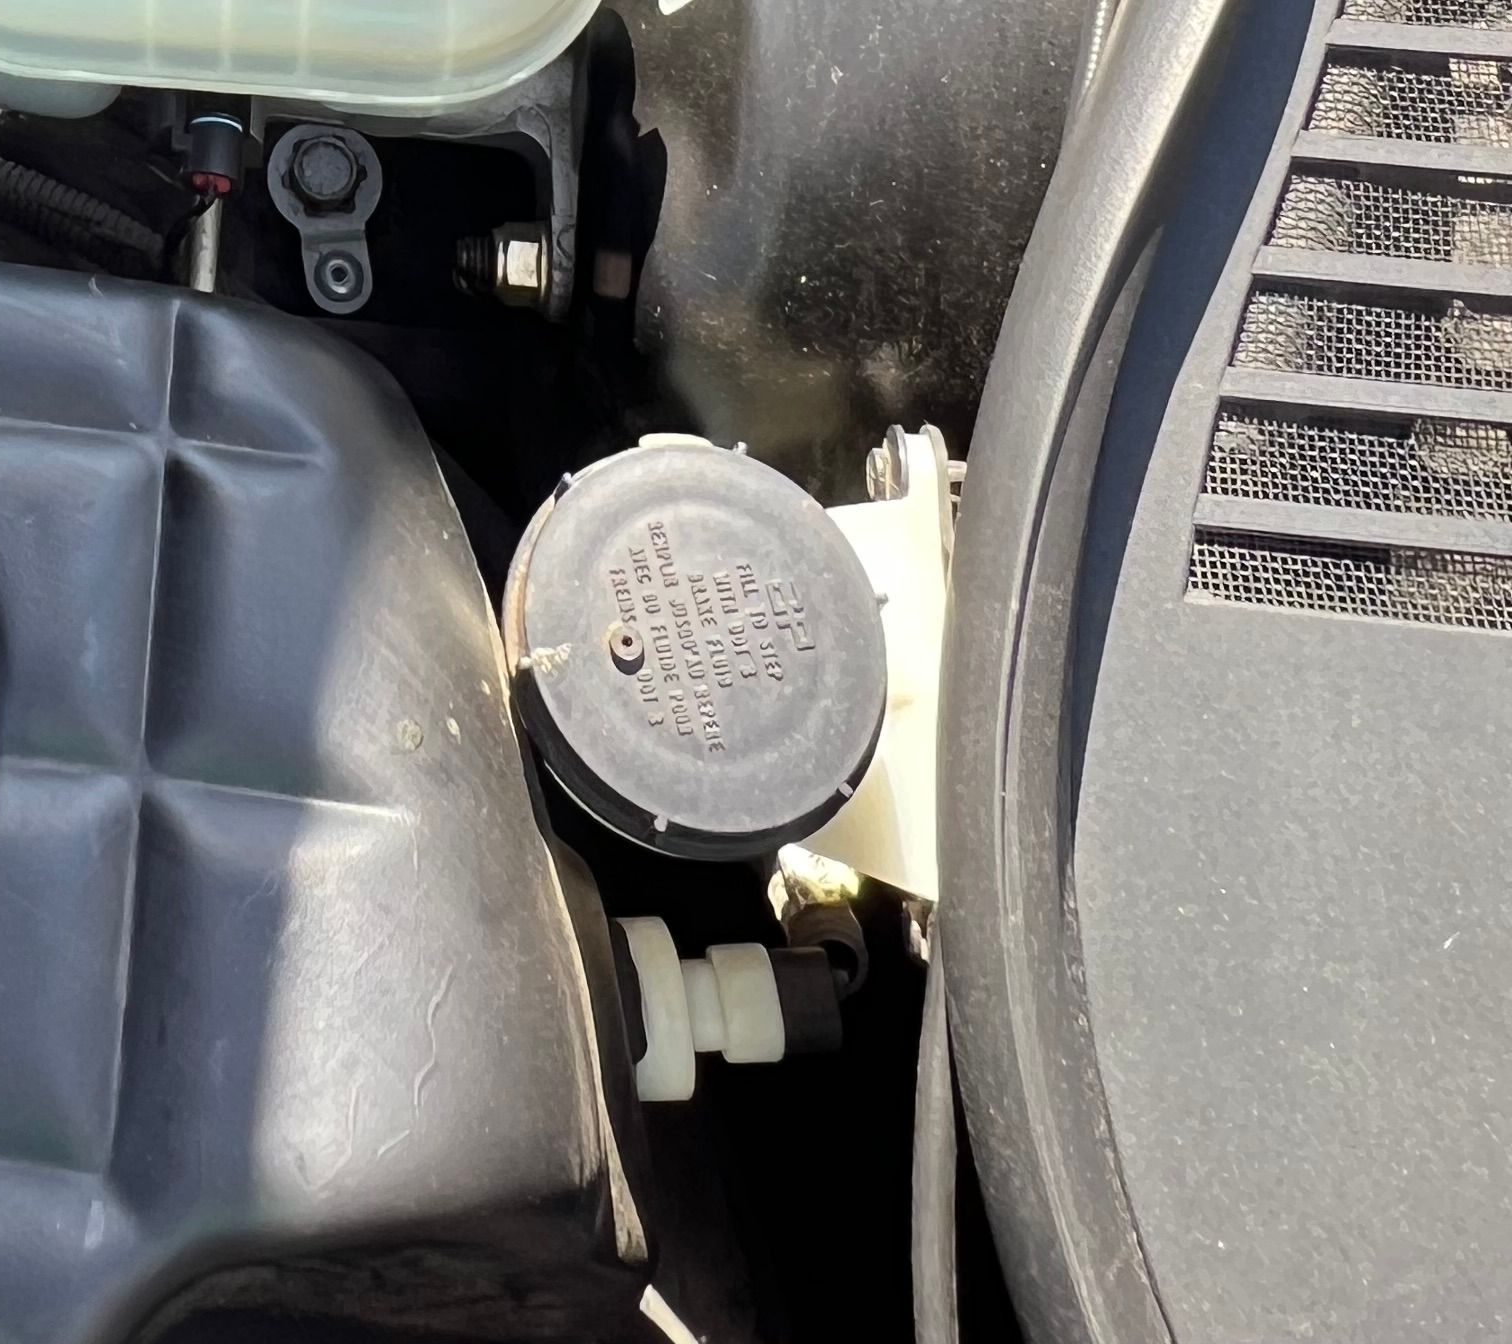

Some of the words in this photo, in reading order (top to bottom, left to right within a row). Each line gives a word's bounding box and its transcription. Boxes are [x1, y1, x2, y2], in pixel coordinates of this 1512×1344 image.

[627, 544, 653, 586] AVEC
[650, 625, 680, 685] FLUIDE
[688, 574, 719, 628] BRAKE
[705, 637, 734, 689] FLUID
[713, 571, 740, 615] WITH
[727, 619, 755, 657] DOT
[736, 563, 760, 599] FILL
[748, 608, 770, 631] TO
[759, 638, 785, 682] STEP
